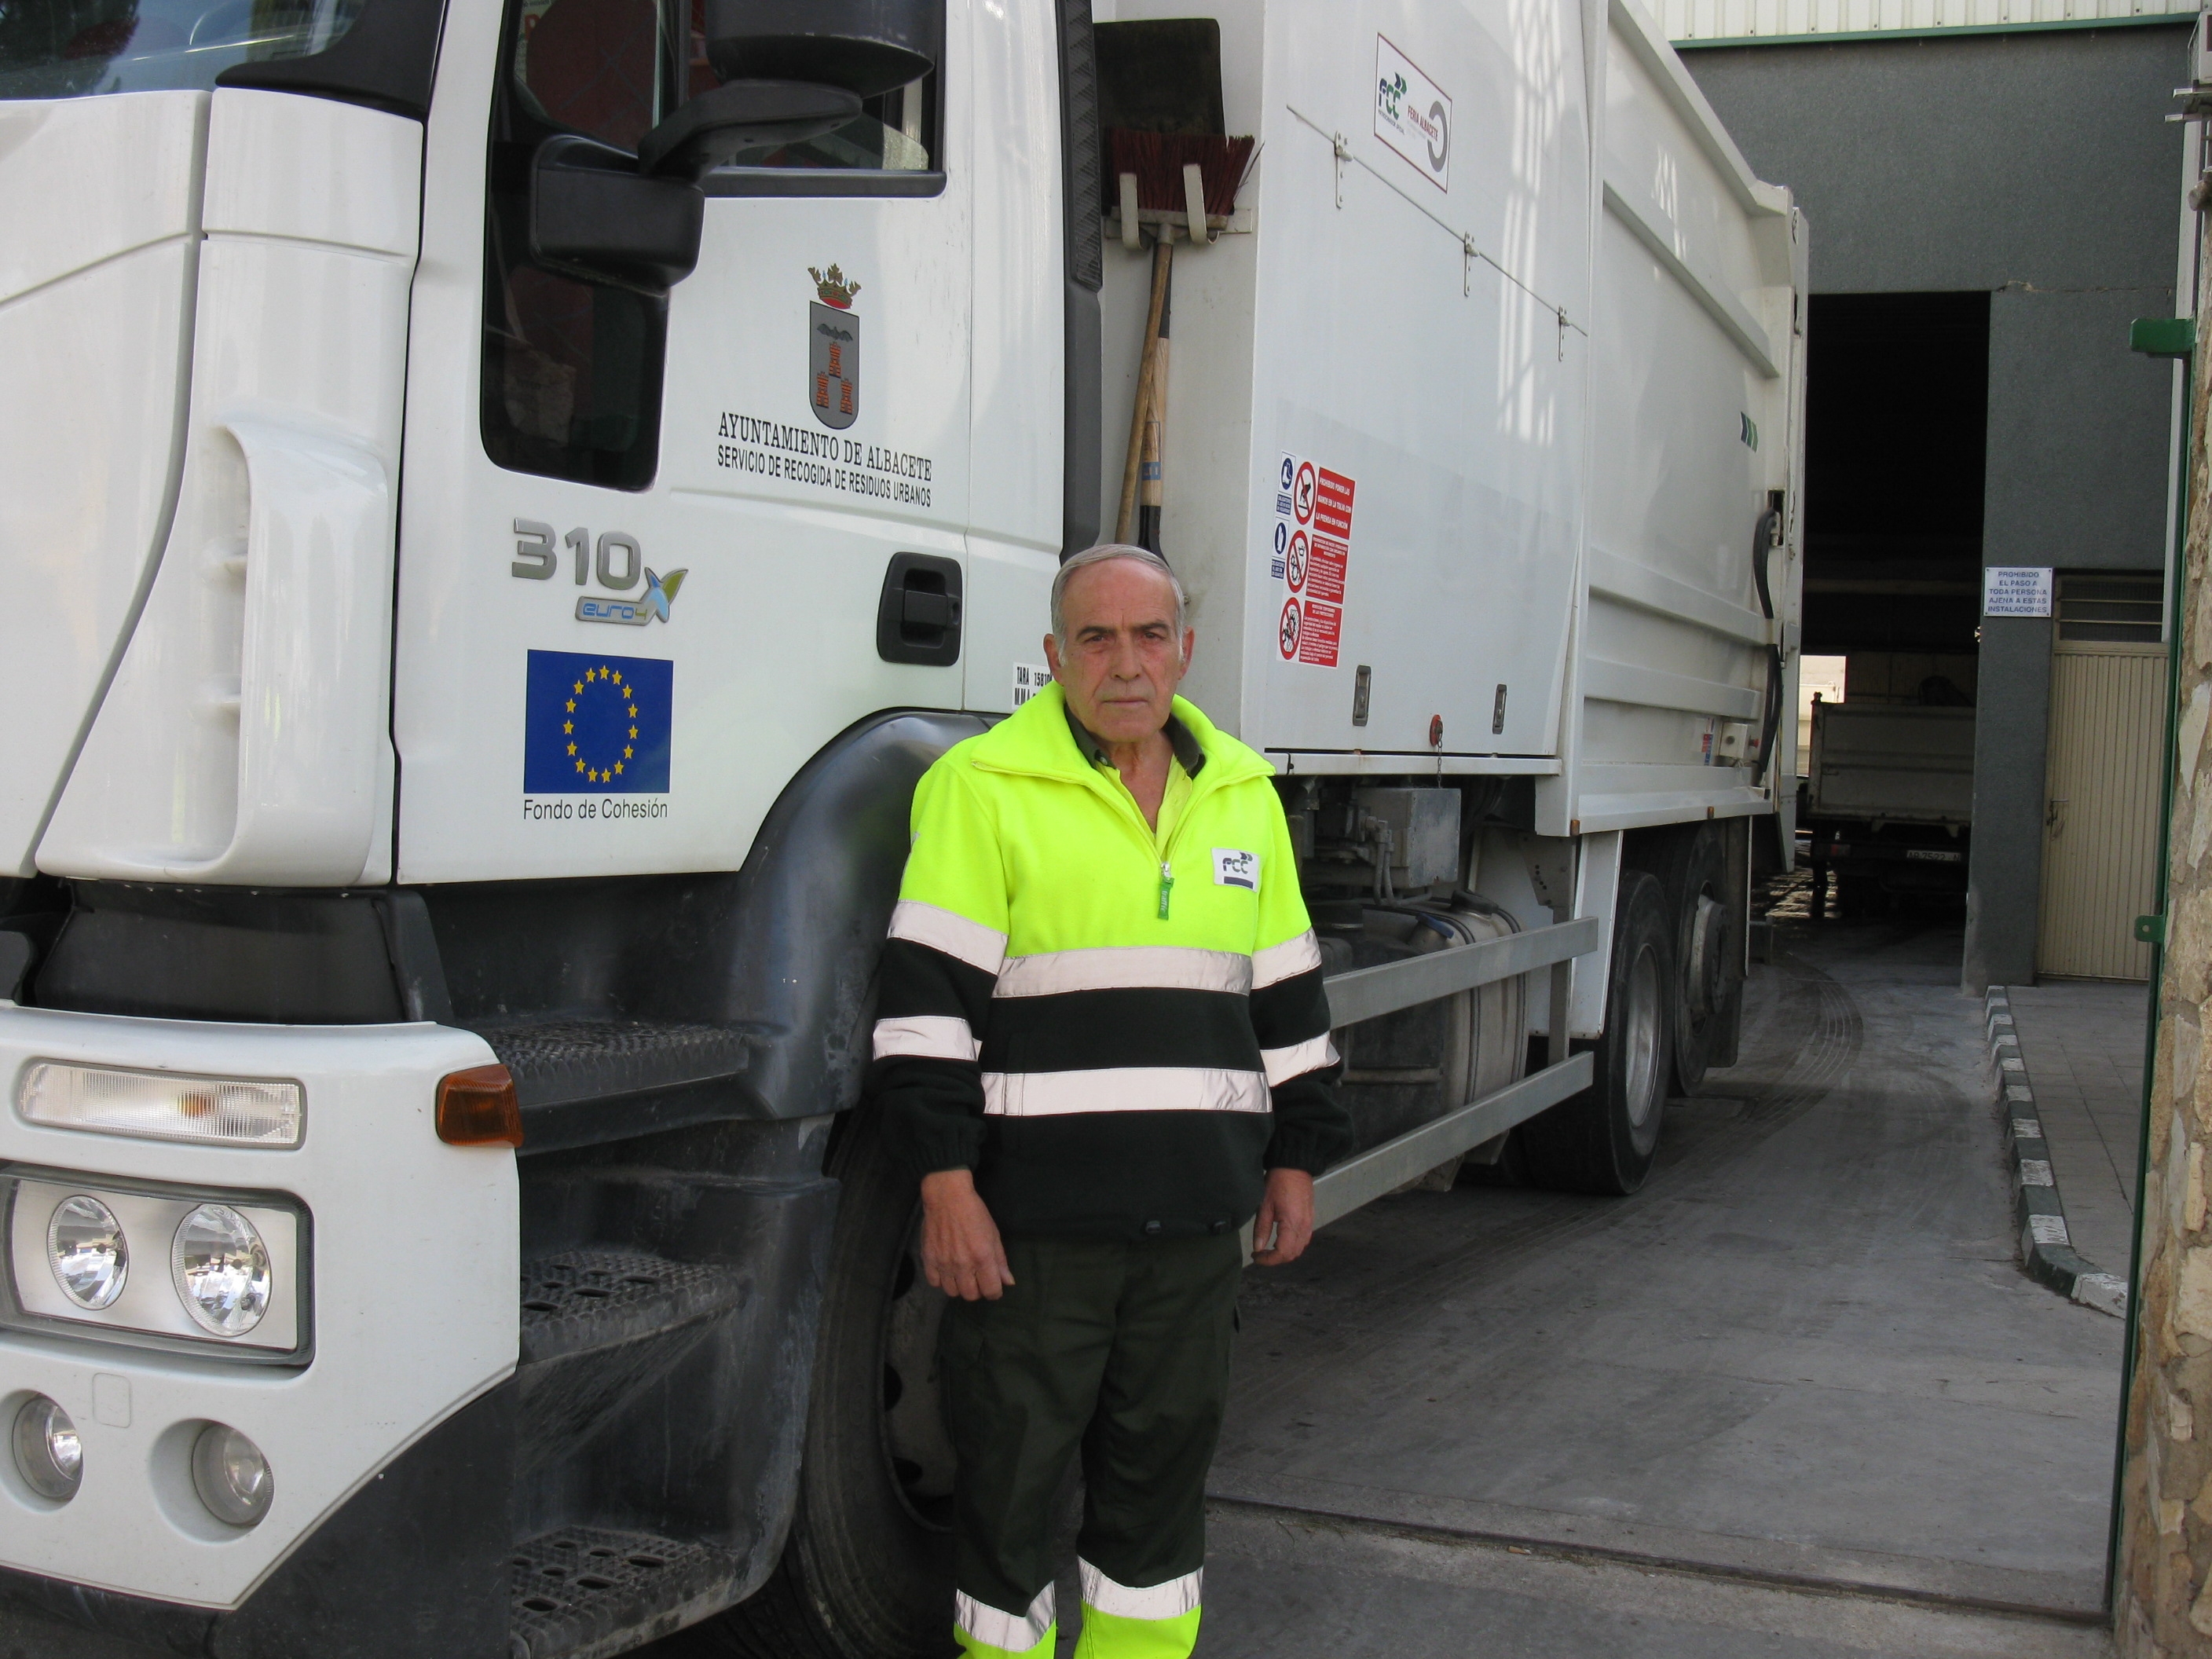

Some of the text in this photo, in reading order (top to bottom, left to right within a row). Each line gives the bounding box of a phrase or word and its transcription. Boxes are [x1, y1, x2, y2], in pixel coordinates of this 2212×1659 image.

[1379, 78, 1401, 120] FCC
[1407, 104, 1419, 125] FERIA
[1419, 115, 1438, 141] ALBACETE
[718, 412, 932, 482] AYUNTAMIENTO DE ALBACETE
[717, 445, 932, 508] SERVICIO DE RECOGIDA DE RESIDUOS URBANOS
[511, 517, 642, 591] 310
[582, 602, 648, 621] euro4
[1016, 666, 1030, 686] TARA
[523, 797, 668, 819] Fondo de Cohesión
[1222, 857, 1248, 874] FCC
